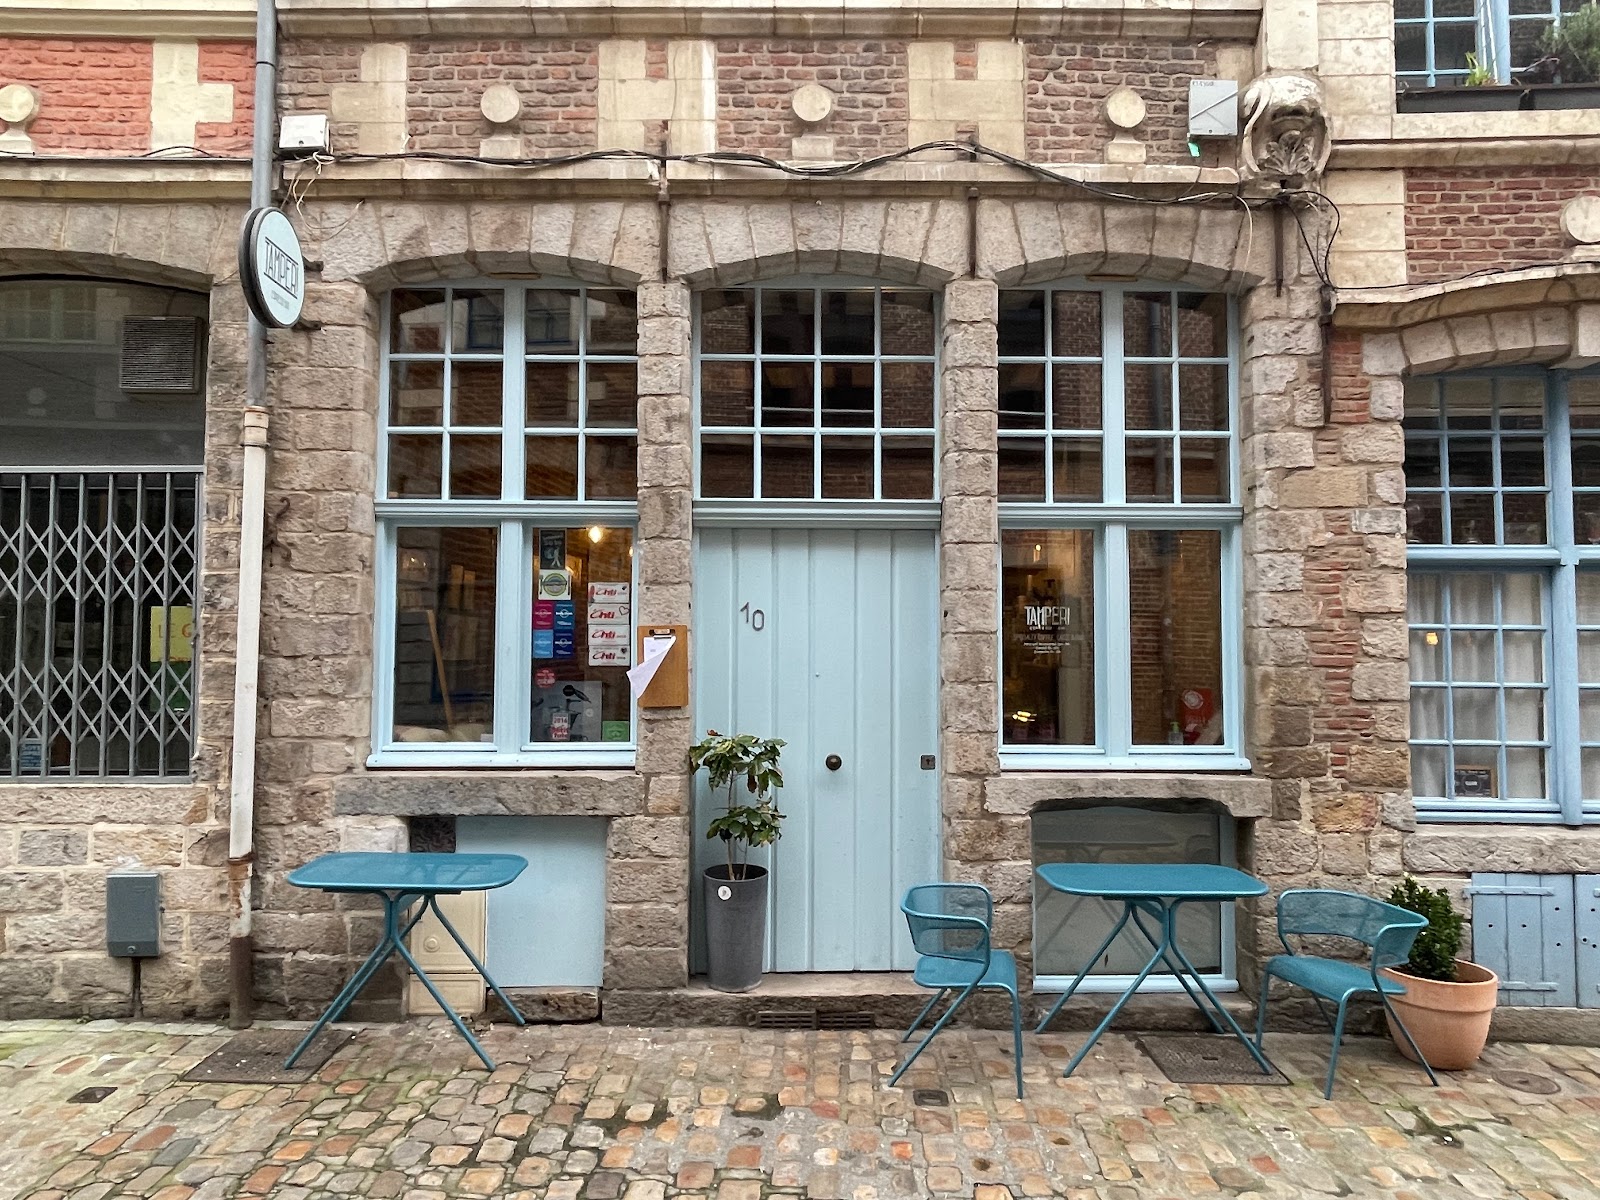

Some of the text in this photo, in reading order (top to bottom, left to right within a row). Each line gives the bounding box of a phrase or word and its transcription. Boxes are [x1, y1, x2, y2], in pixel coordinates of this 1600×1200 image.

[265, 240, 298, 294] TAMPERI
[739, 601, 765, 632] 10
[1024, 605, 1070, 627] TAMPERI
